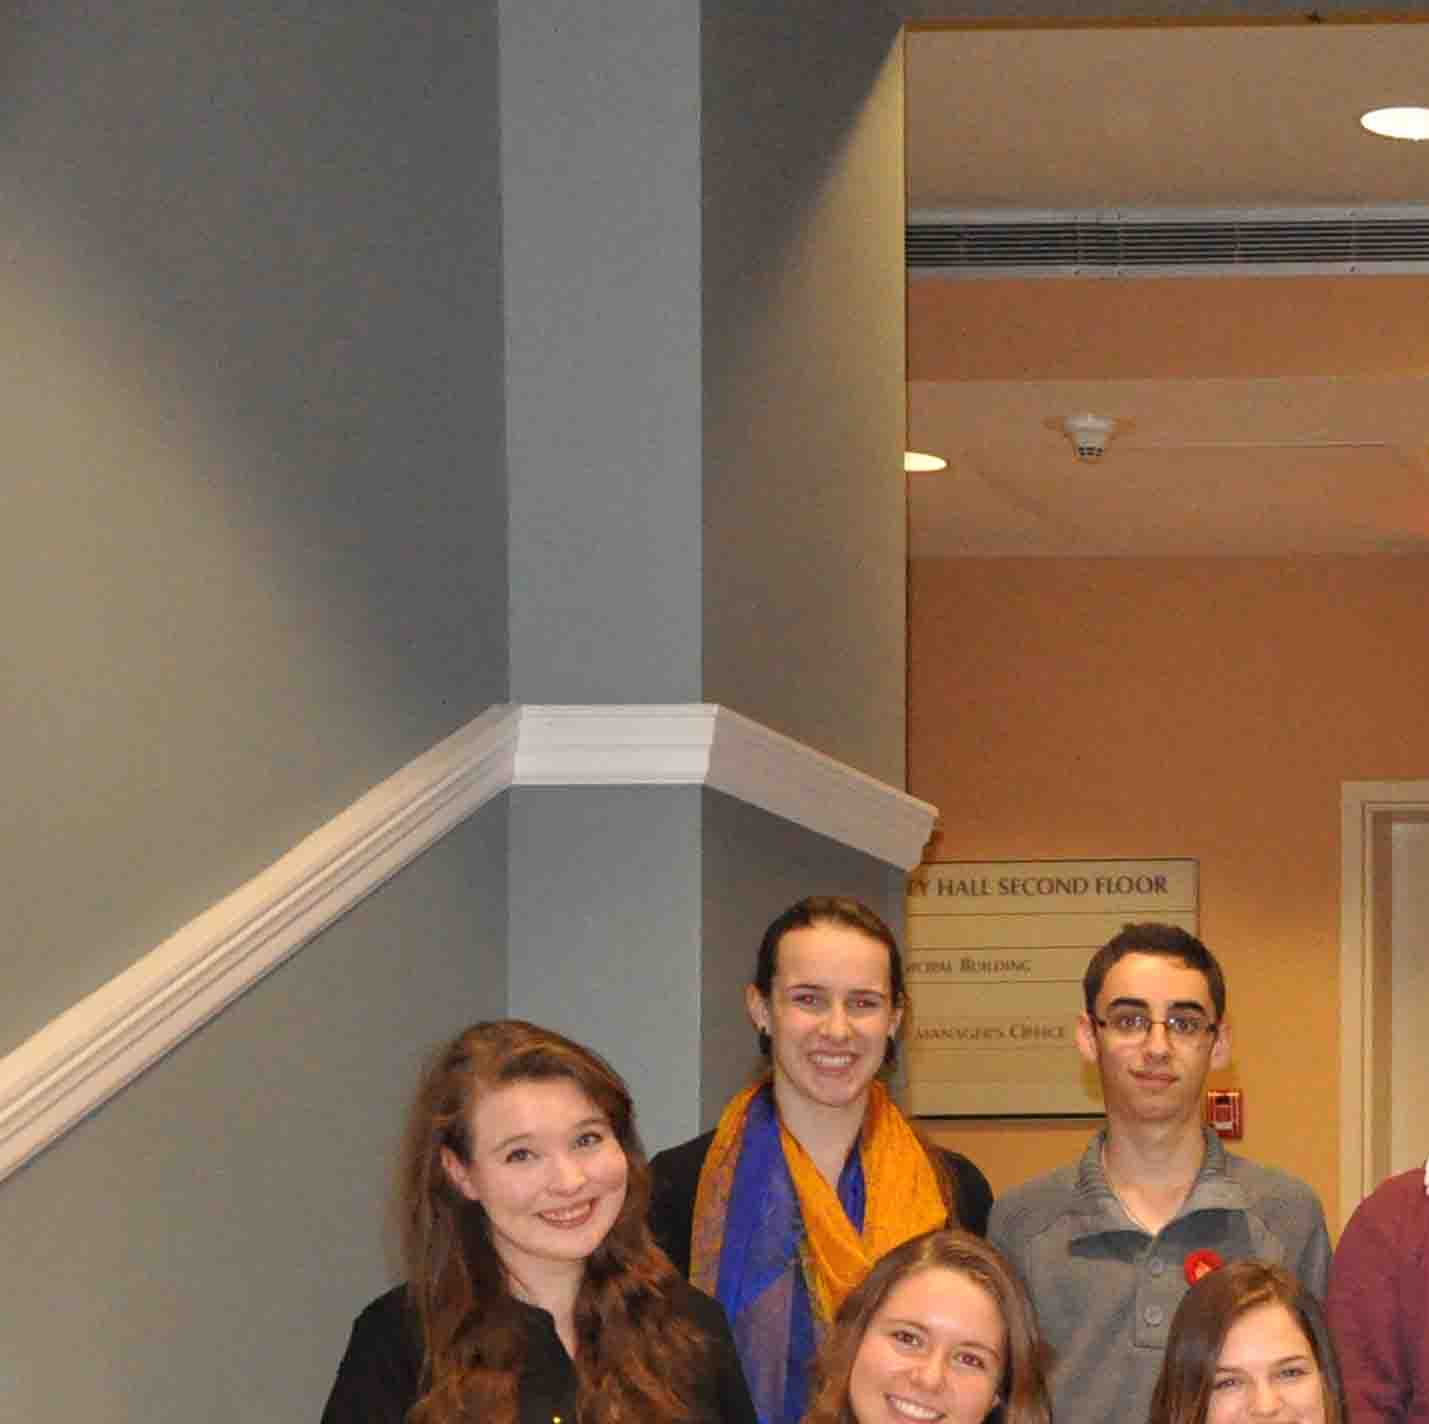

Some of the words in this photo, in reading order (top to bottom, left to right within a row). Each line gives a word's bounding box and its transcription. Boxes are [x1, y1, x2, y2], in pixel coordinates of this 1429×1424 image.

[936, 877, 992, 896] HALL
[998, 876, 1088, 896] SECOND
[1095, 874, 1168, 895] FLOOR
